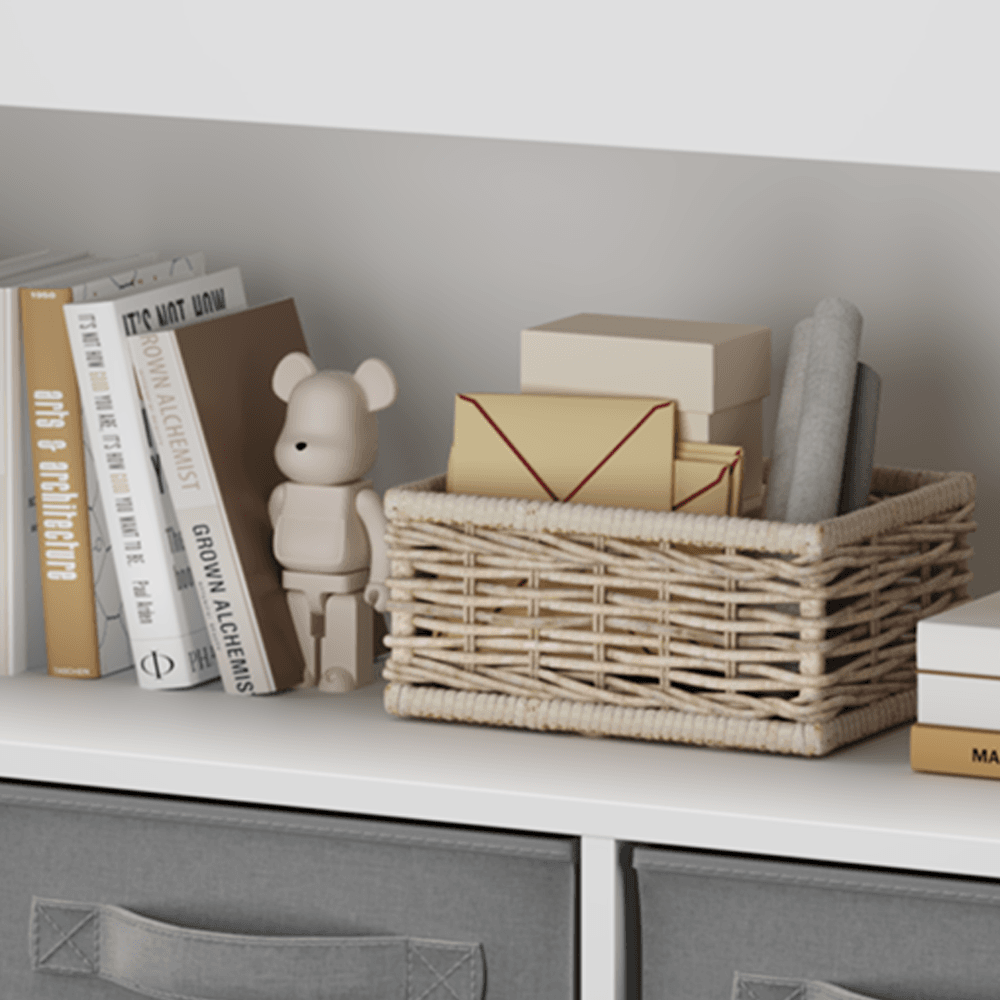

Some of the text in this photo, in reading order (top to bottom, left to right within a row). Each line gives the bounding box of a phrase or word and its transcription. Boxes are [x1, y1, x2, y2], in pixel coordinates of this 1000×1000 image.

[121, 287, 227, 337] IT'S NOT HOW
[33, 390, 69, 428] arts
[156, 392, 201, 491] ALCHEMIST
[39, 462, 80, 580] architecture
[192, 523, 226, 593] GROWN
